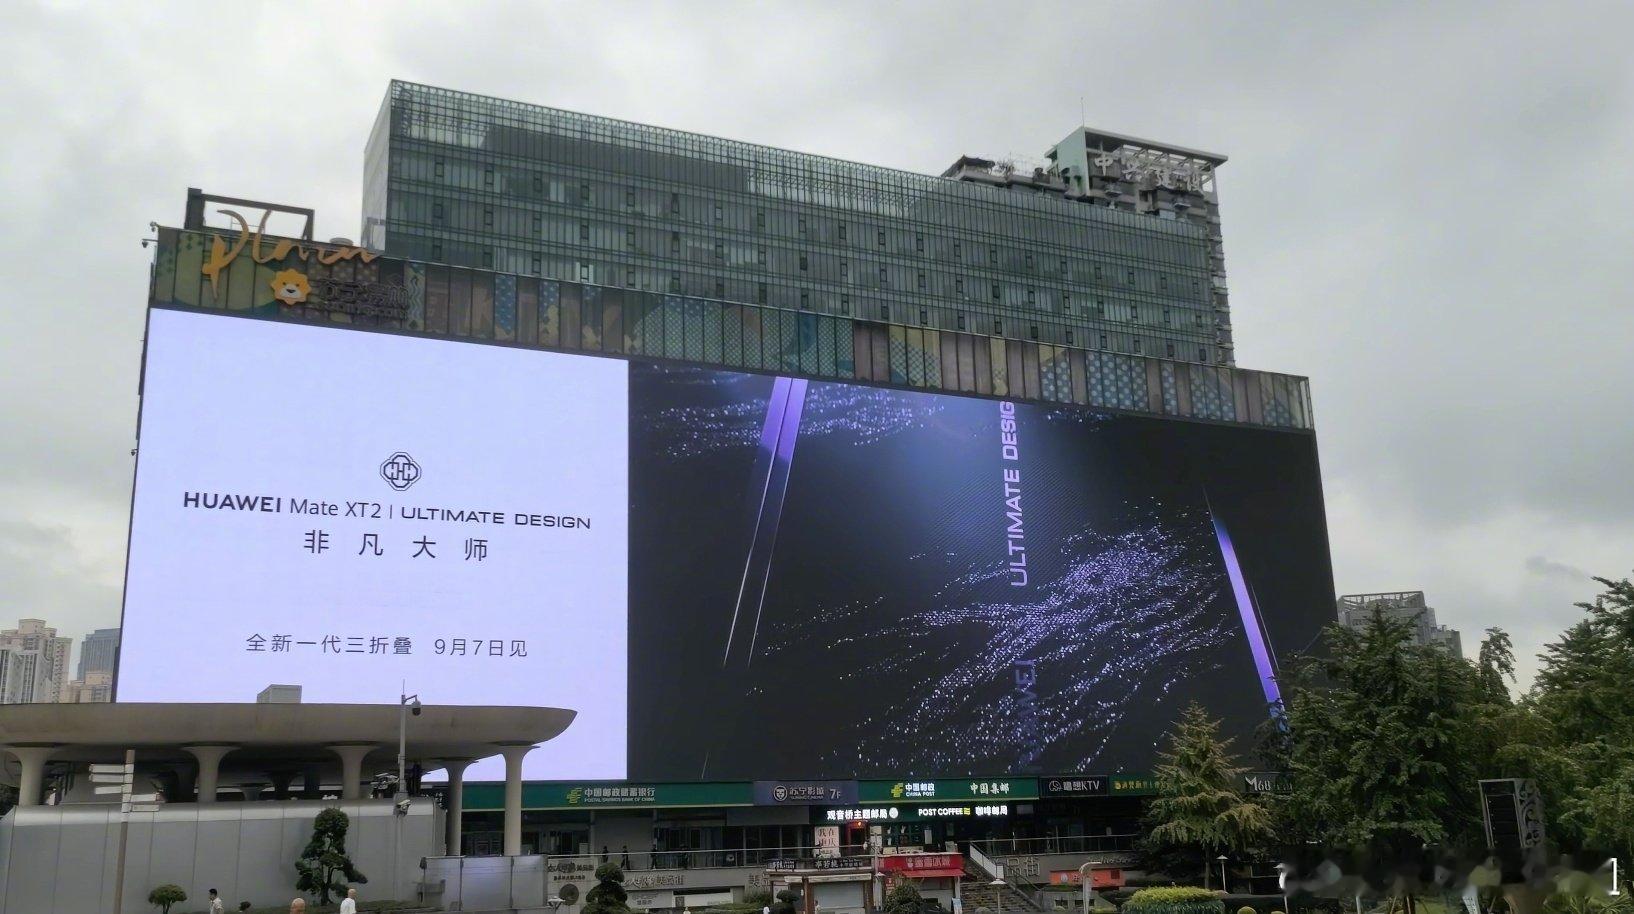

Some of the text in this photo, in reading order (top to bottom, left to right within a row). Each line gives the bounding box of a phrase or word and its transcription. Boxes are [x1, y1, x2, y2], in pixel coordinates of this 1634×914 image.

[183, 491, 591, 530] HUAWEI Mate XT2 ULTIMATE DESIGN
[1003, 468, 1028, 587] ULTIMATE
[303, 529, 488, 562] 非凡大师
[246, 633, 528, 658] 全新一代三折叠 9月7日见
[789, 786, 824, 796] 苏宁影城
[905, 782, 935, 791] 中国邮政
[970, 782, 1009, 794] 中国集邮
[826, 808, 888, 820] 观音桥主题邮局
[918, 808, 937, 817] POST
[937, 807, 963, 816] COFFEE
